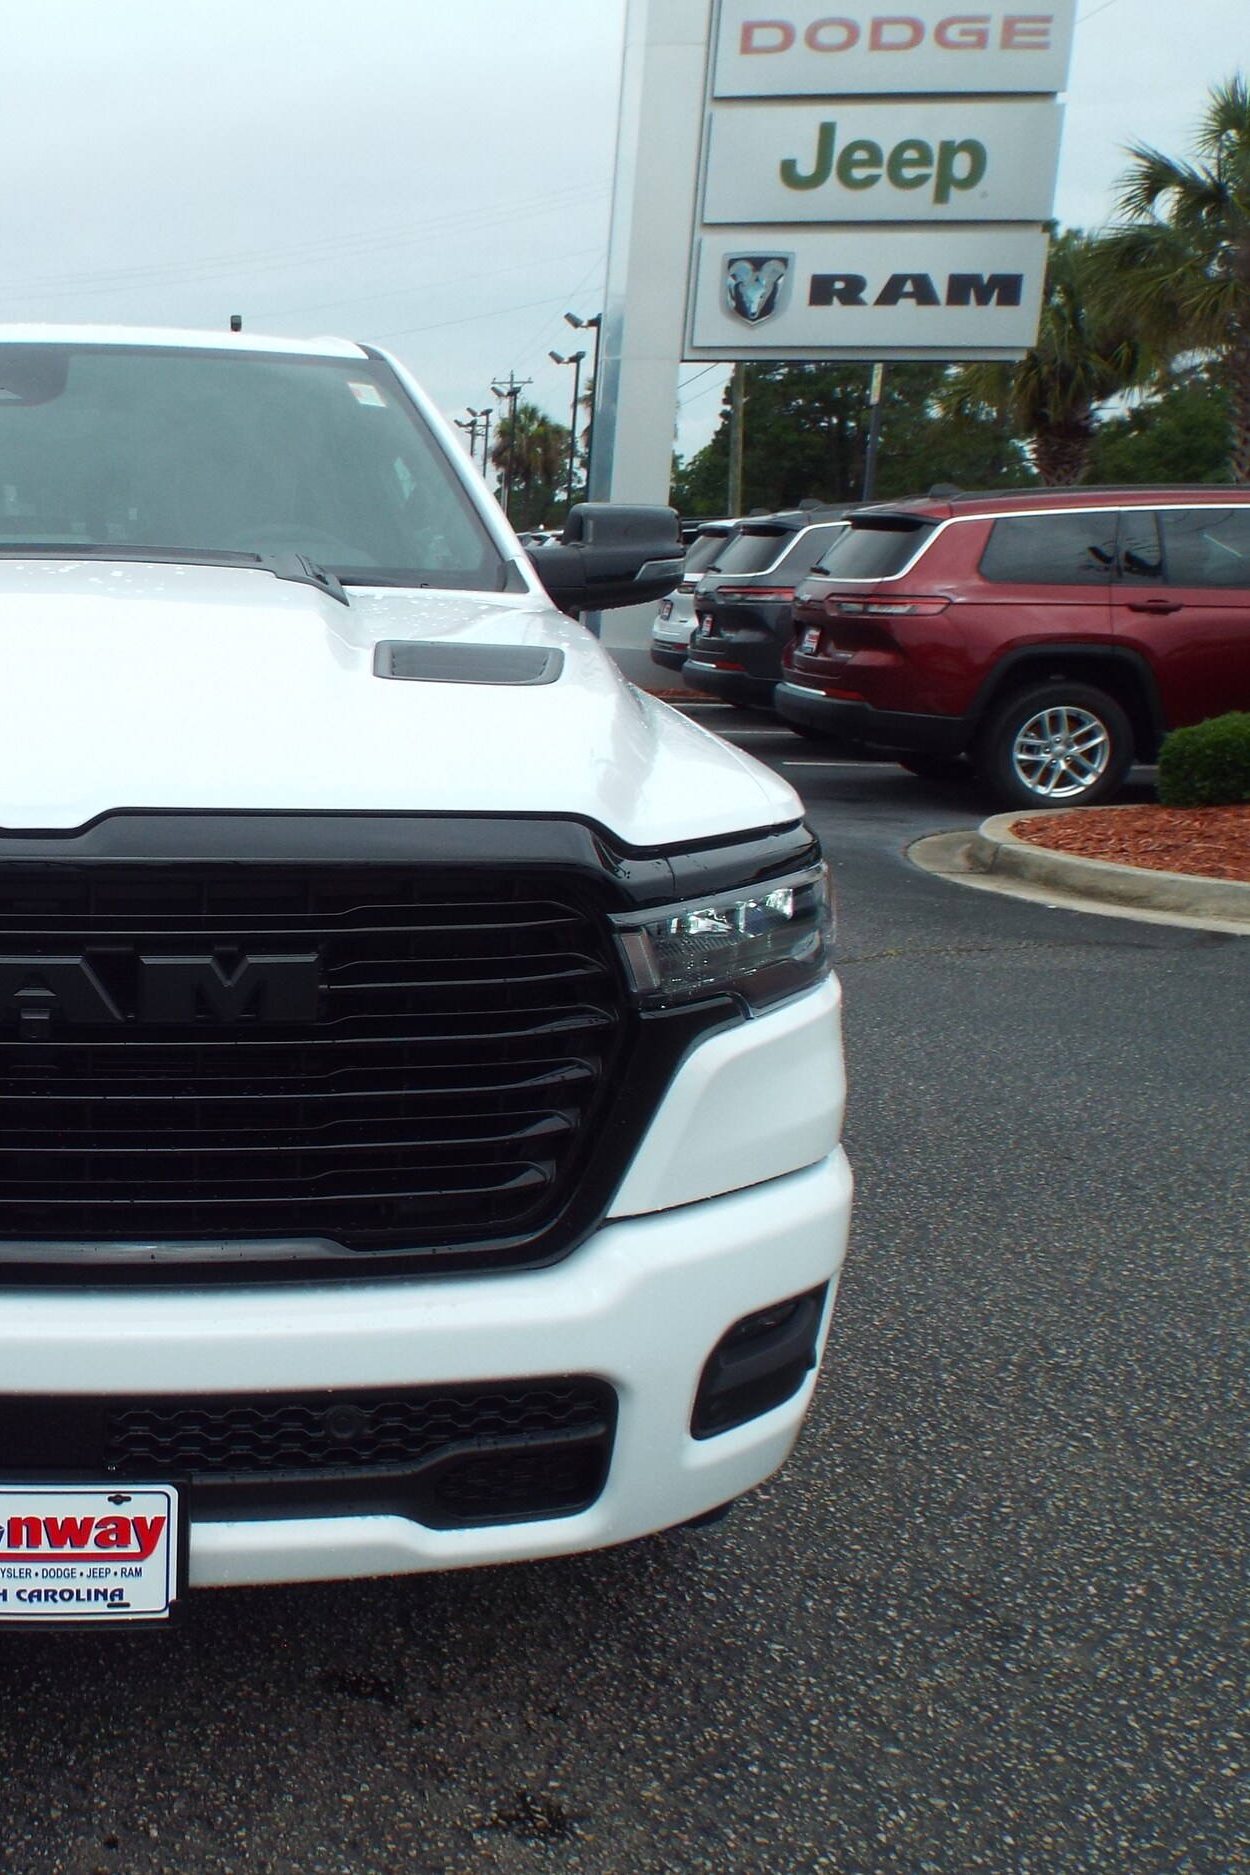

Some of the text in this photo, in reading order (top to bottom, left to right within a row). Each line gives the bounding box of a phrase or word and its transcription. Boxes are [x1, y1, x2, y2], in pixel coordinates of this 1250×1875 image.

[739, 15, 1053, 55] DODGE
[780, 121, 988, 205] Jeep
[808, 273, 1024, 307] RAM
[41, 1567, 77, 1579] DODGE
[86, 1567, 111, 1579] JEEP
[120, 1567, 143, 1578] RAM
[16, 1587, 125, 1604] CAROLINA
